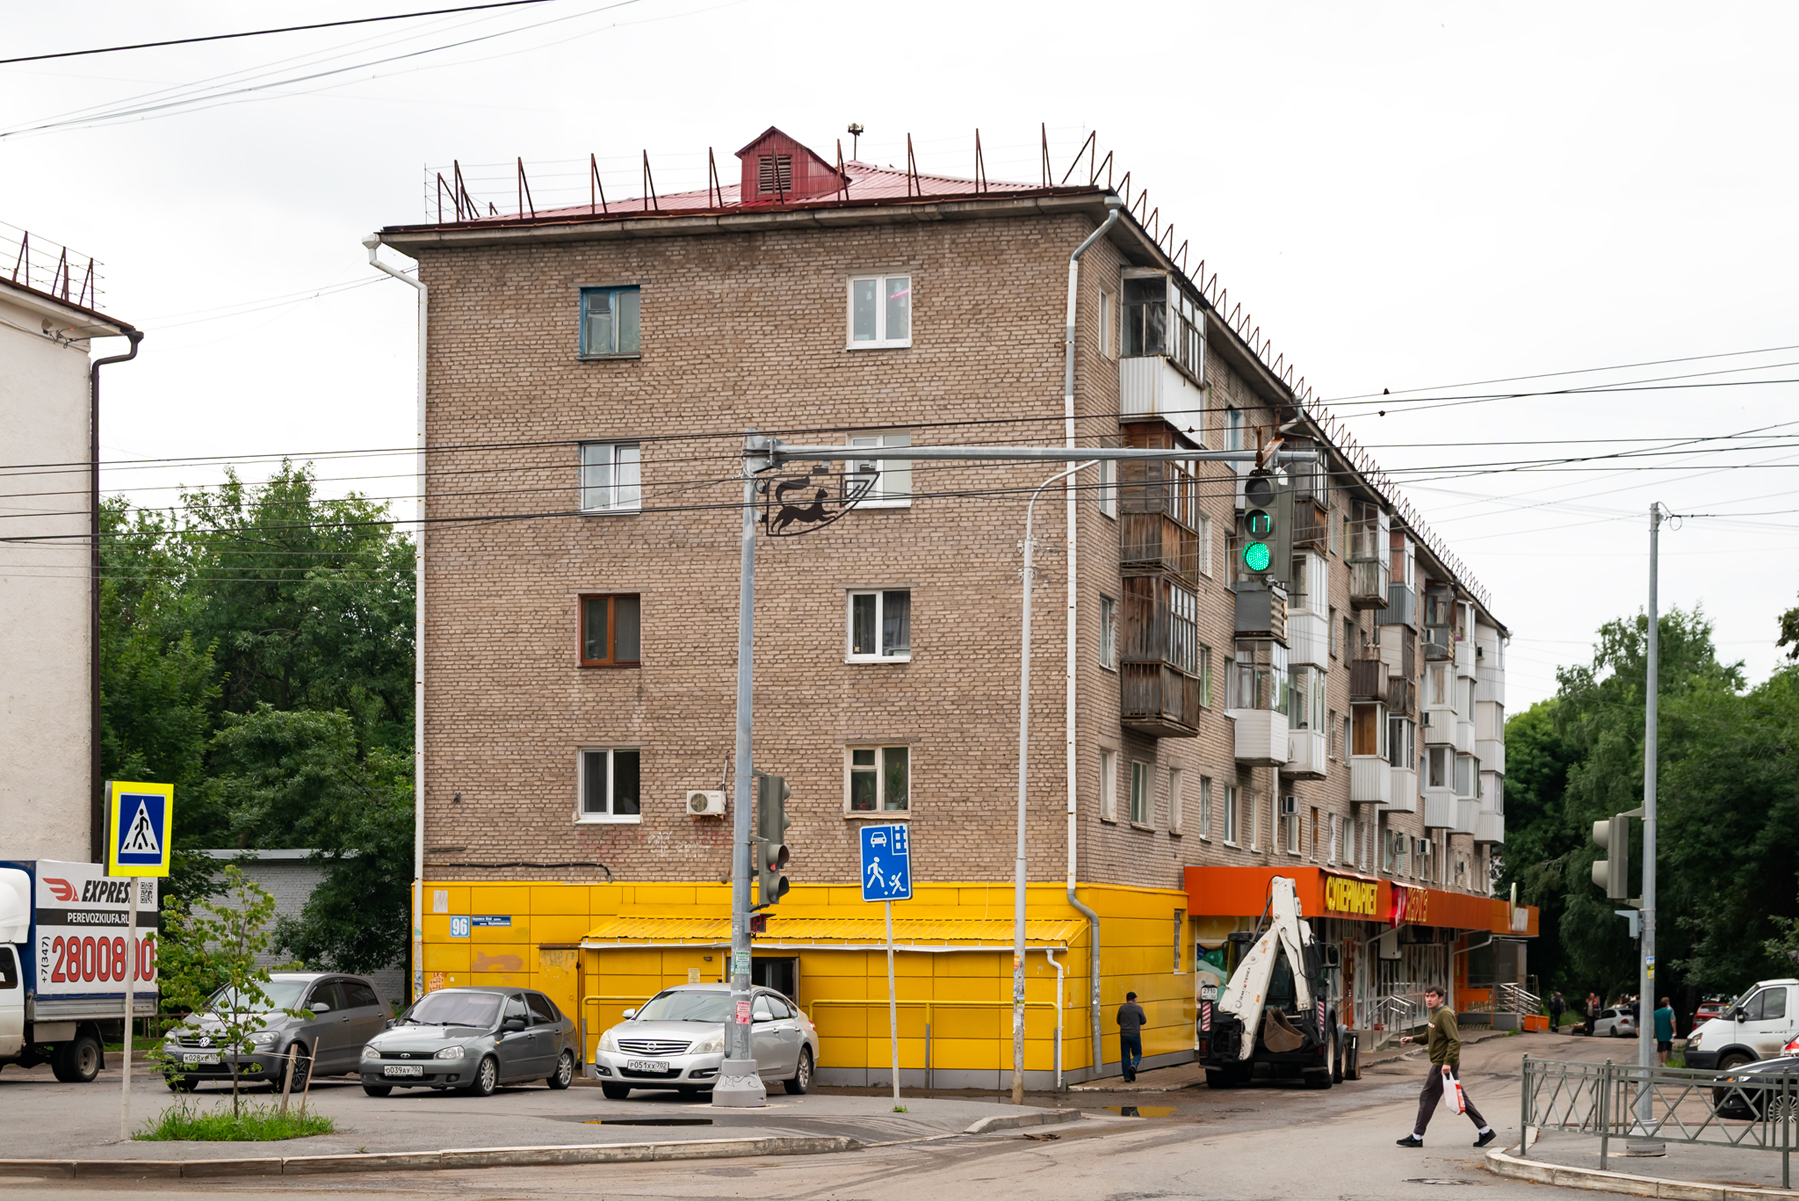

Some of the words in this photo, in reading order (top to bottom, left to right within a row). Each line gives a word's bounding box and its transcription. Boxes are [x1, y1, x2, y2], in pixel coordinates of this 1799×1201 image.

[1252, 515, 1271, 533] 17
[81, 879, 139, 904] EXPRES
[1326, 876, 1378, 915] СУПЕРМАРКЕТ
[67, 912, 130, 925] PEREVOZKIUFA.RU
[452, 918, 468, 936] 96
[41, 936, 51, 983] +7(347)
